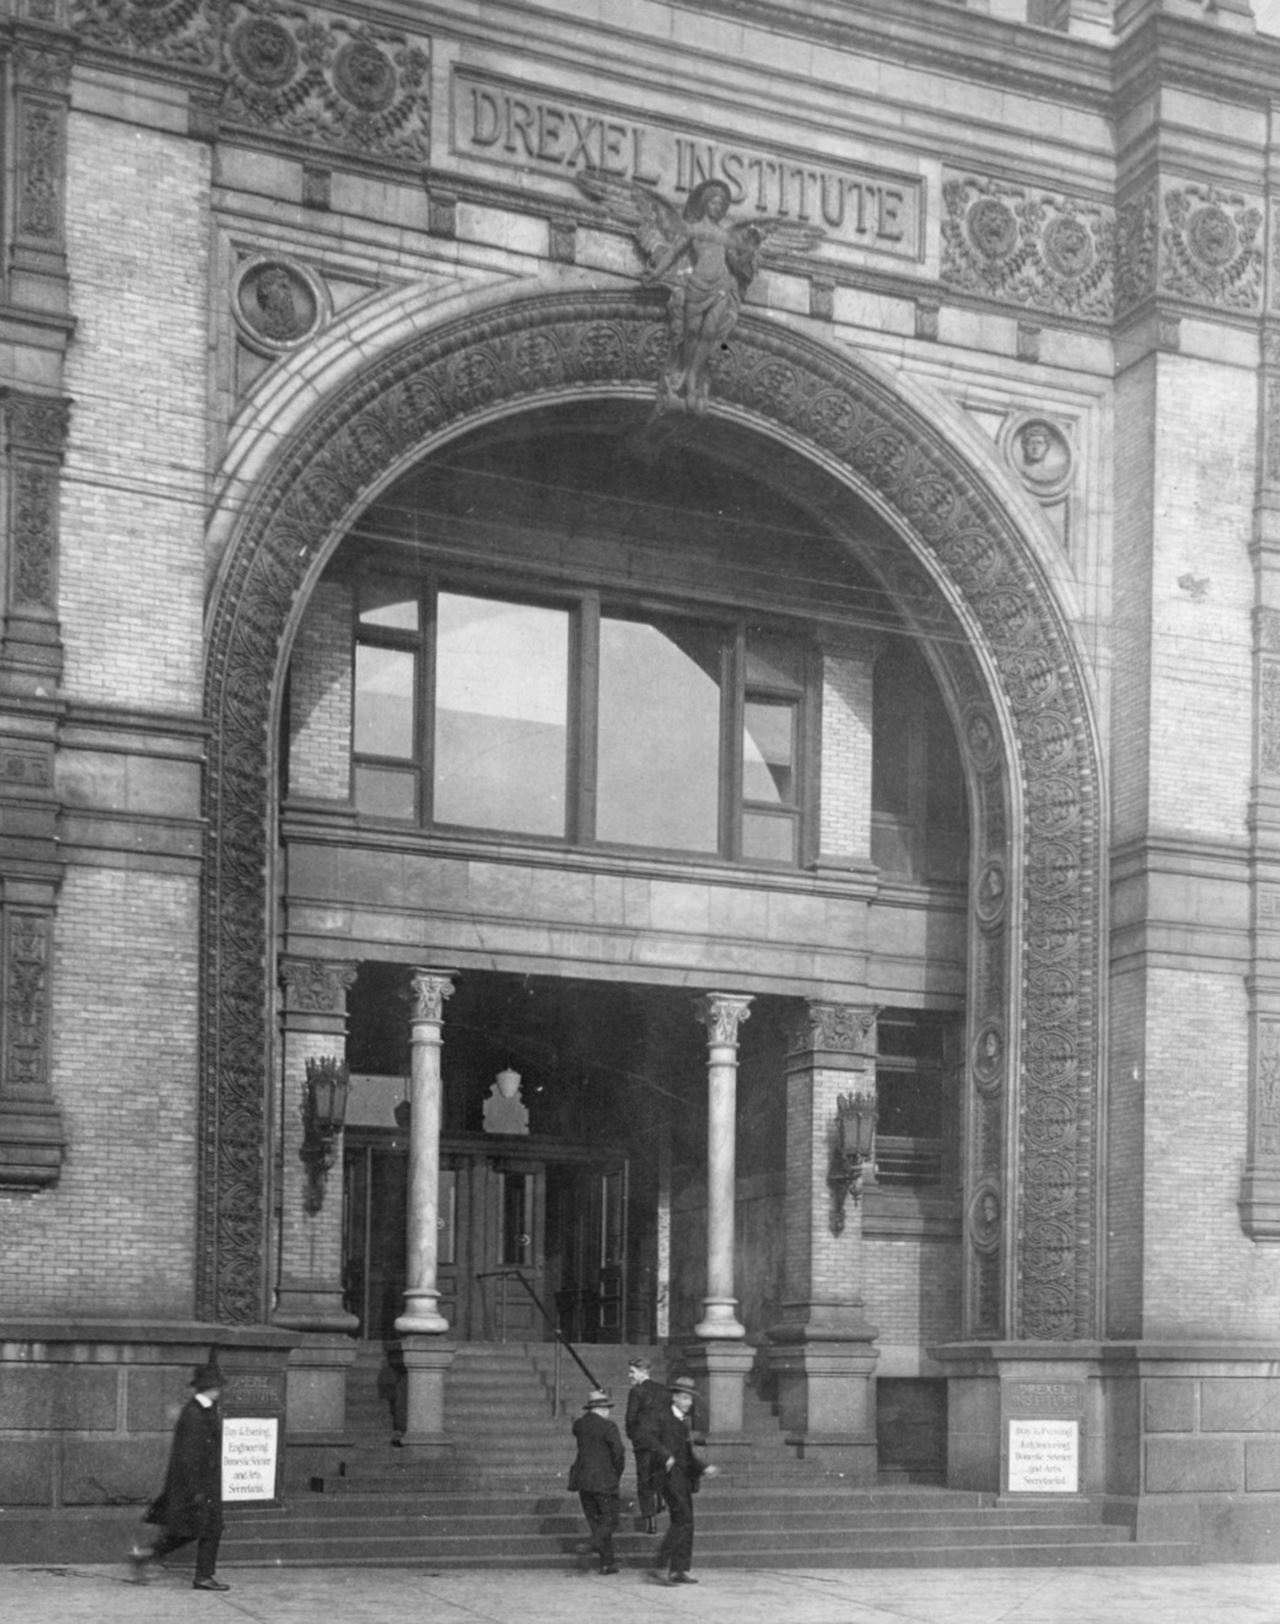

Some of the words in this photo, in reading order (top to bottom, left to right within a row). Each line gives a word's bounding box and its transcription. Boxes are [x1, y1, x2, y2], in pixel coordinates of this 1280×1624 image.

[471, 87, 661, 187] DREXEL
[674, 138, 904, 242] INSTITUTE
[1019, 1383, 1068, 1395] DREXEL
